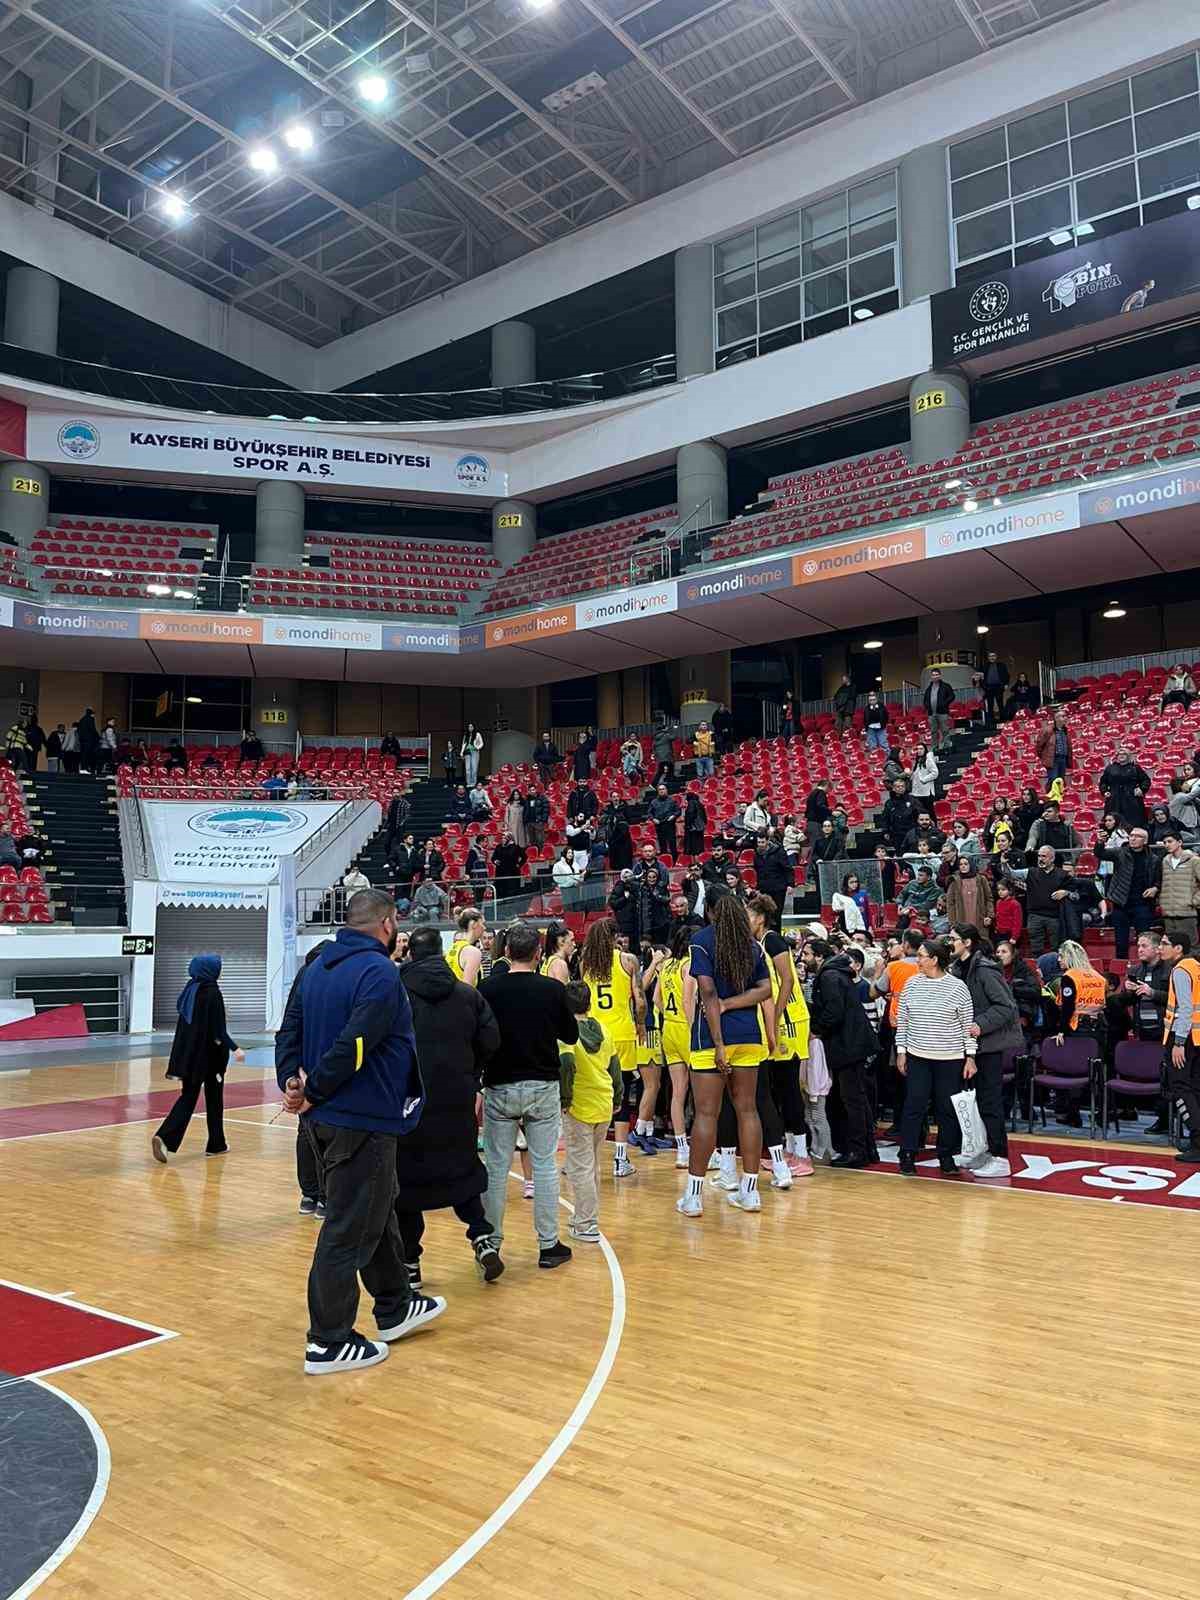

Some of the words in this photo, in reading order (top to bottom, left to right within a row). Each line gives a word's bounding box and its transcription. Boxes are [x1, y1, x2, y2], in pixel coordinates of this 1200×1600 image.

[1076, 274, 1122, 298] POTA
[953, 332, 970, 344] T.C.
[972, 317, 1014, 339] GENÇLİK
[1016, 312, 1029, 323] VE
[953, 340, 977, 355] SPOR
[979, 322, 1030, 348] BAKANLIĞI
[917, 393, 943, 411] 216
[130, 432, 209, 450] KAYSERİ
[213, 437, 328, 459] BÜYÜKŞEHİR
[332, 449, 431, 468] BELEDİYESİ
[233, 456, 289, 472] SPOR
[297, 461, 335, 478] A.Ş.
[15, 479, 40, 493] 219
[500, 515, 520, 526] 217
[956, 508, 1065, 543] mondihome
[818, 540, 913, 572] mondihome
[699, 567, 784, 598] mondihome
[595, 592, 669, 619] mondihome
[38, 614, 129, 631] mondihome
[166, 621, 253, 637] mondihome
[504, 613, 568, 638] mondihome
[288, 626, 371, 642] mondihome
[406, 633, 479, 647] mondihome
[928, 652, 953, 666] 116
[264, 711, 285, 721] 118
[174, 860, 276, 868] BELEDİYESİ
[597, 984, 613, 1010] 5
[665, 992, 678, 1015] 4
